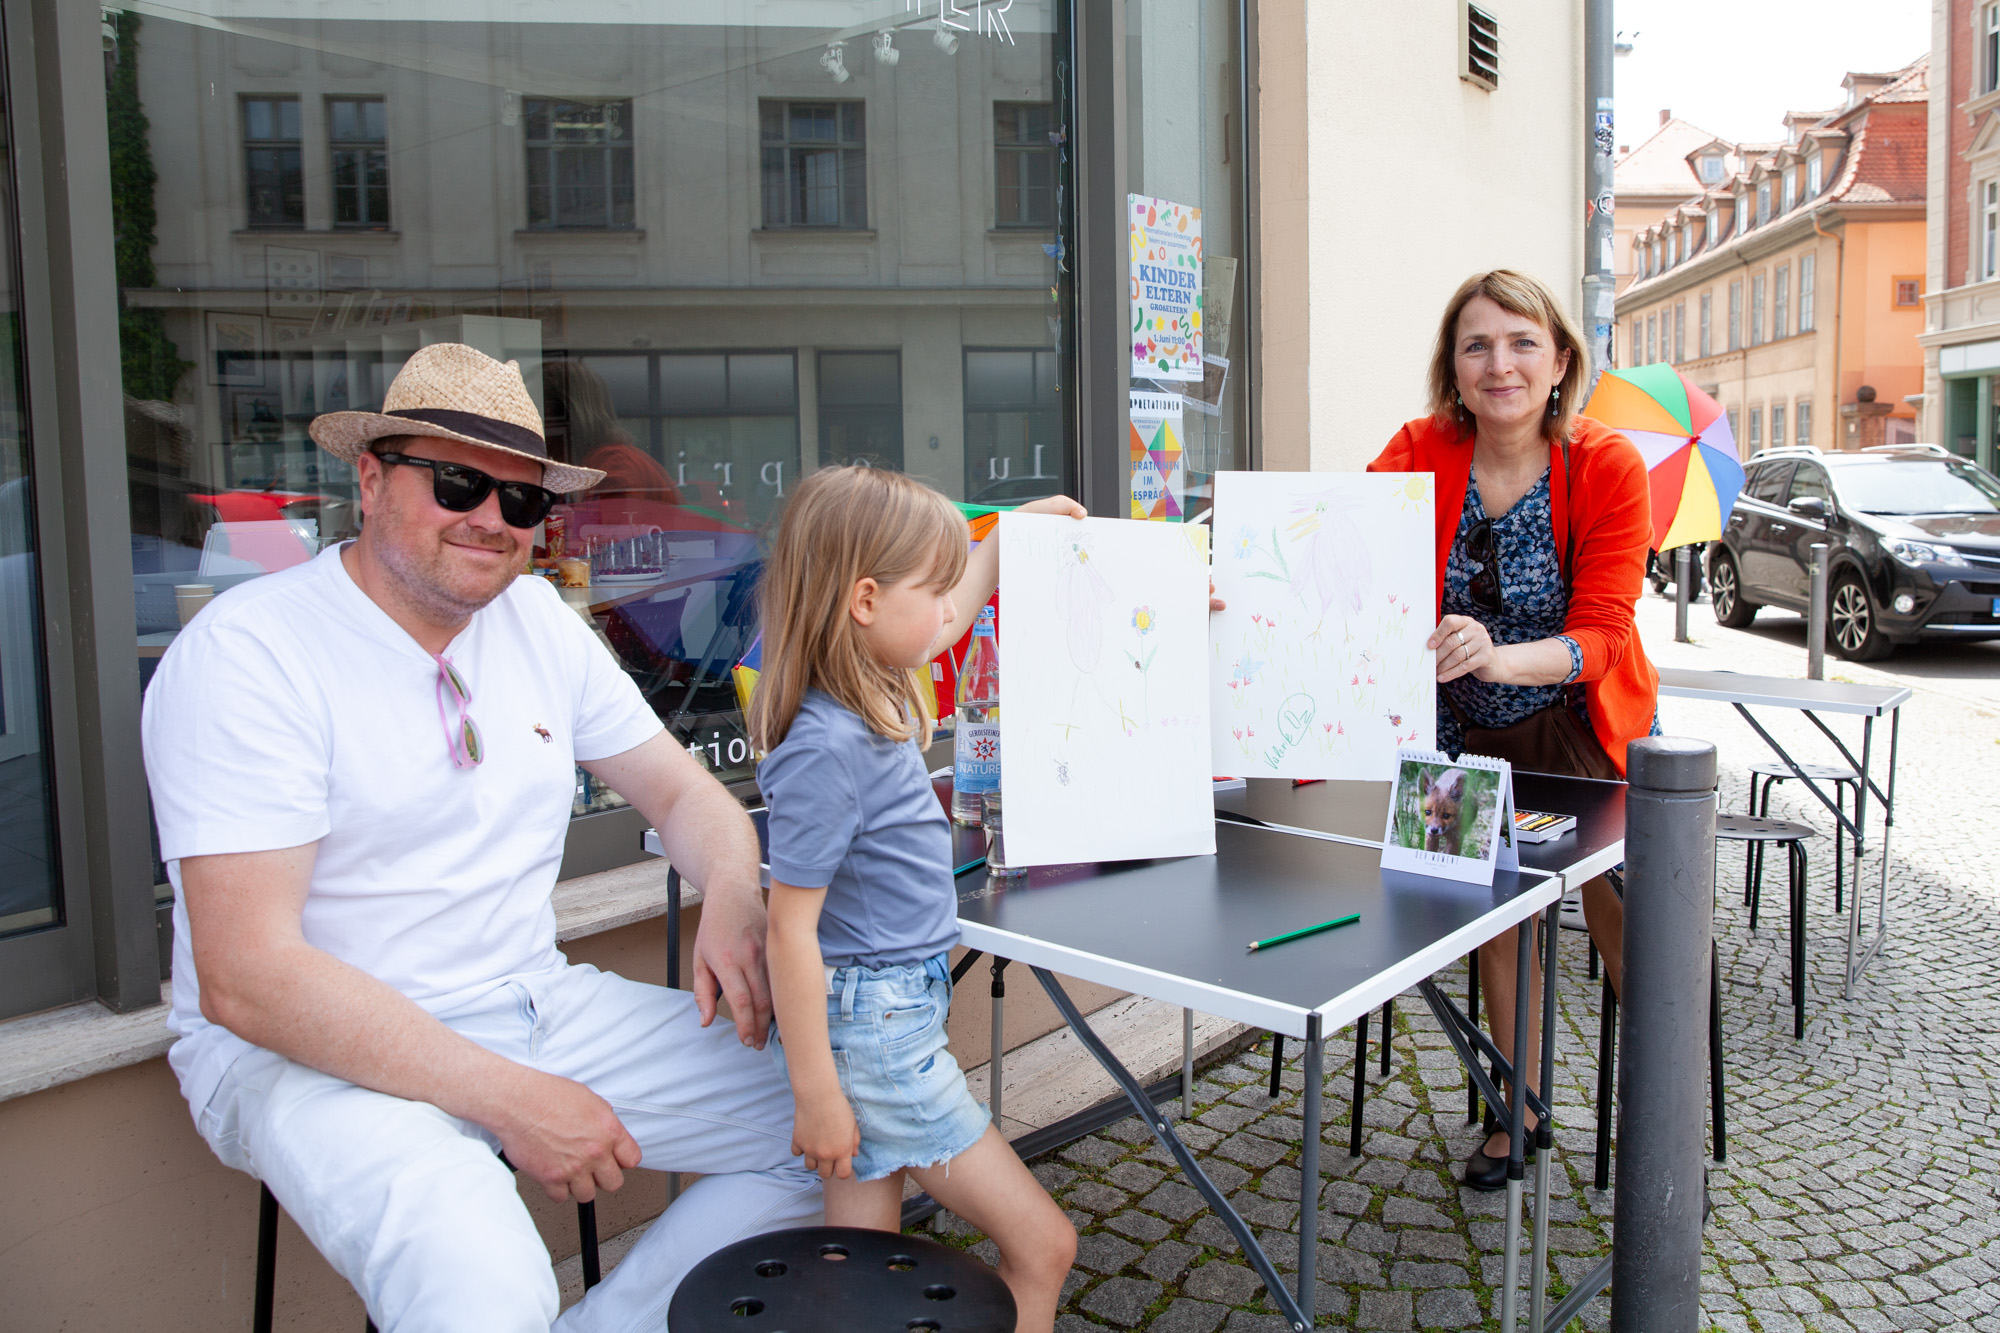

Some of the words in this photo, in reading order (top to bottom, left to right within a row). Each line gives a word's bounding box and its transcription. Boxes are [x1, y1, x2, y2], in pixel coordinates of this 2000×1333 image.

[1144, 226, 1172, 238] Internationalen
[1174, 232, 1192, 243] Kindertag
[1139, 264, 1197, 290] KINDER
[1146, 285, 1191, 304] ELTERN
[1159, 335, 1171, 344] Juni
[1171, 336, 1185, 345] 11:00
[1143, 475, 1153, 486] IM
[1415, 850, 1428, 860] DER
[1431, 853, 1459, 865] MOMENT
